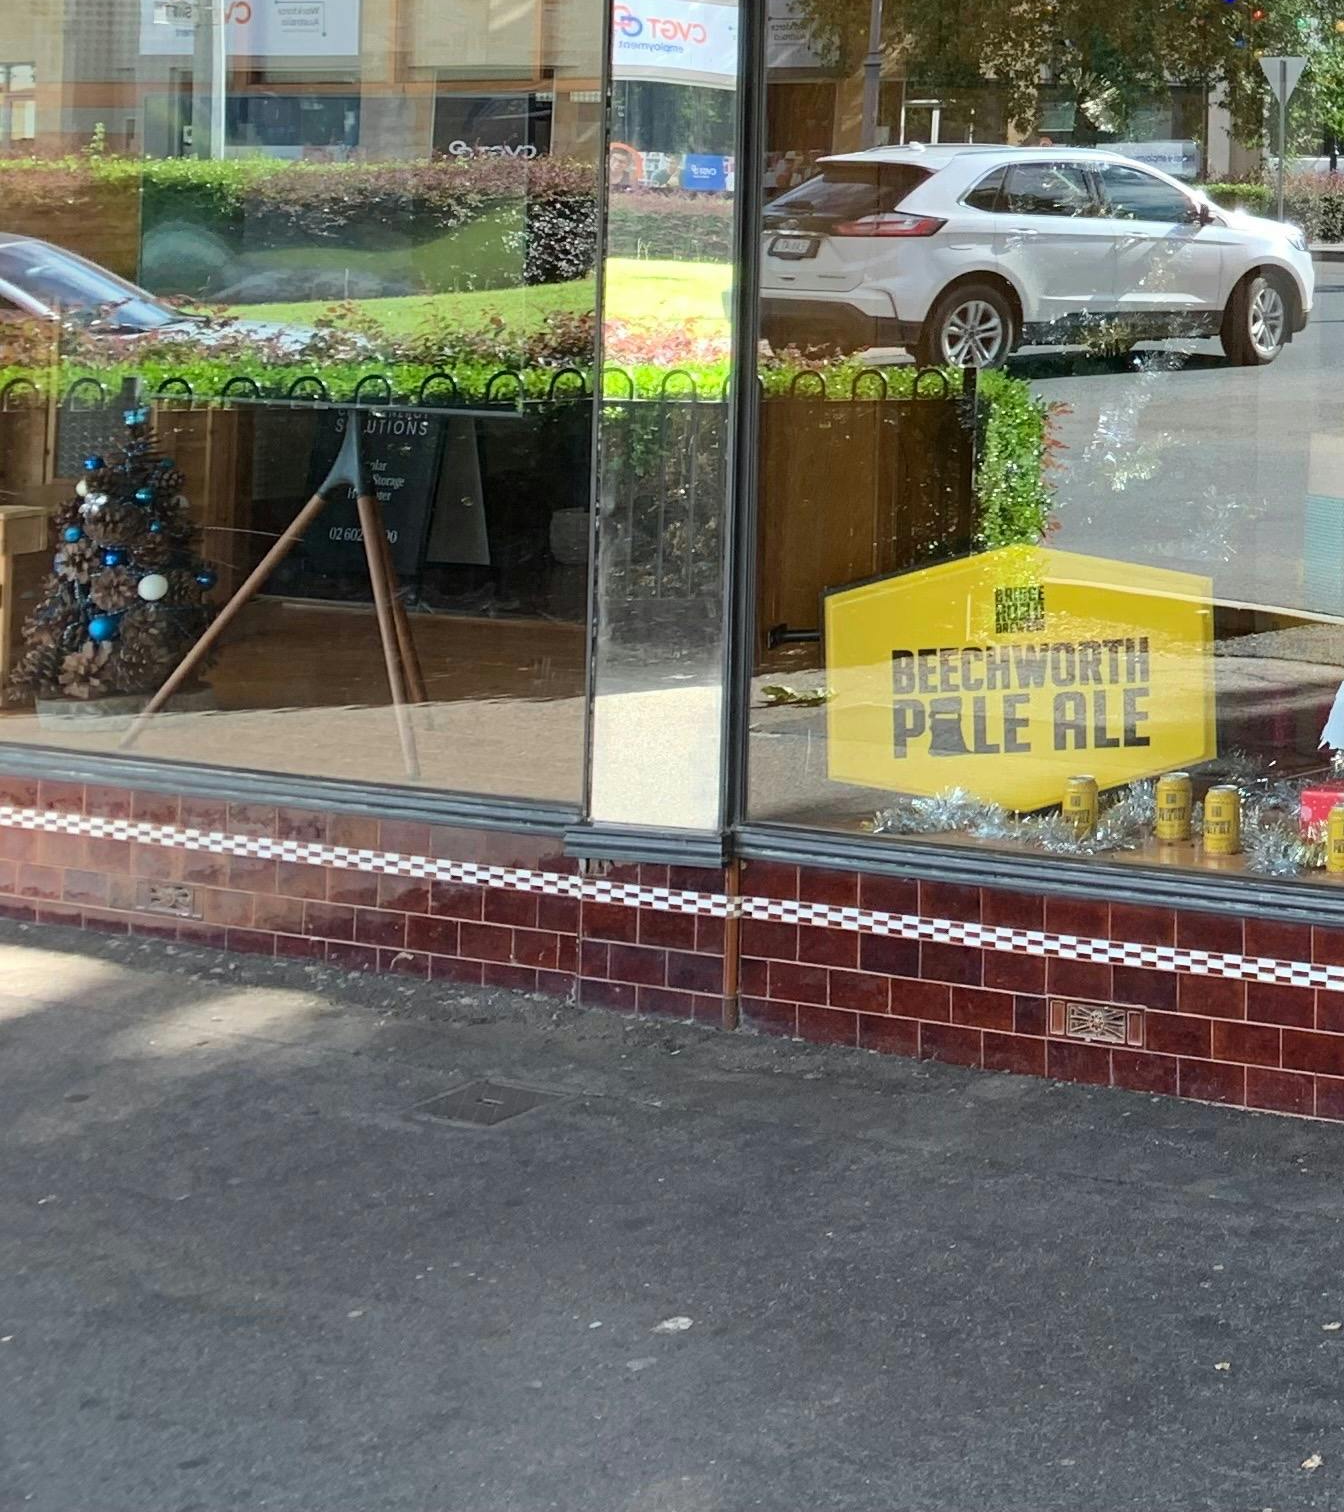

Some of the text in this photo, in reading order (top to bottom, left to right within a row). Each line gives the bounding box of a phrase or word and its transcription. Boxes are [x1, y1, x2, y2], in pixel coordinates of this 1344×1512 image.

[335, 418, 428, 436] SUTIONS
[892, 637, 1150, 695] BEECHWORTH
[893, 688, 1151, 760] PALE ALE
